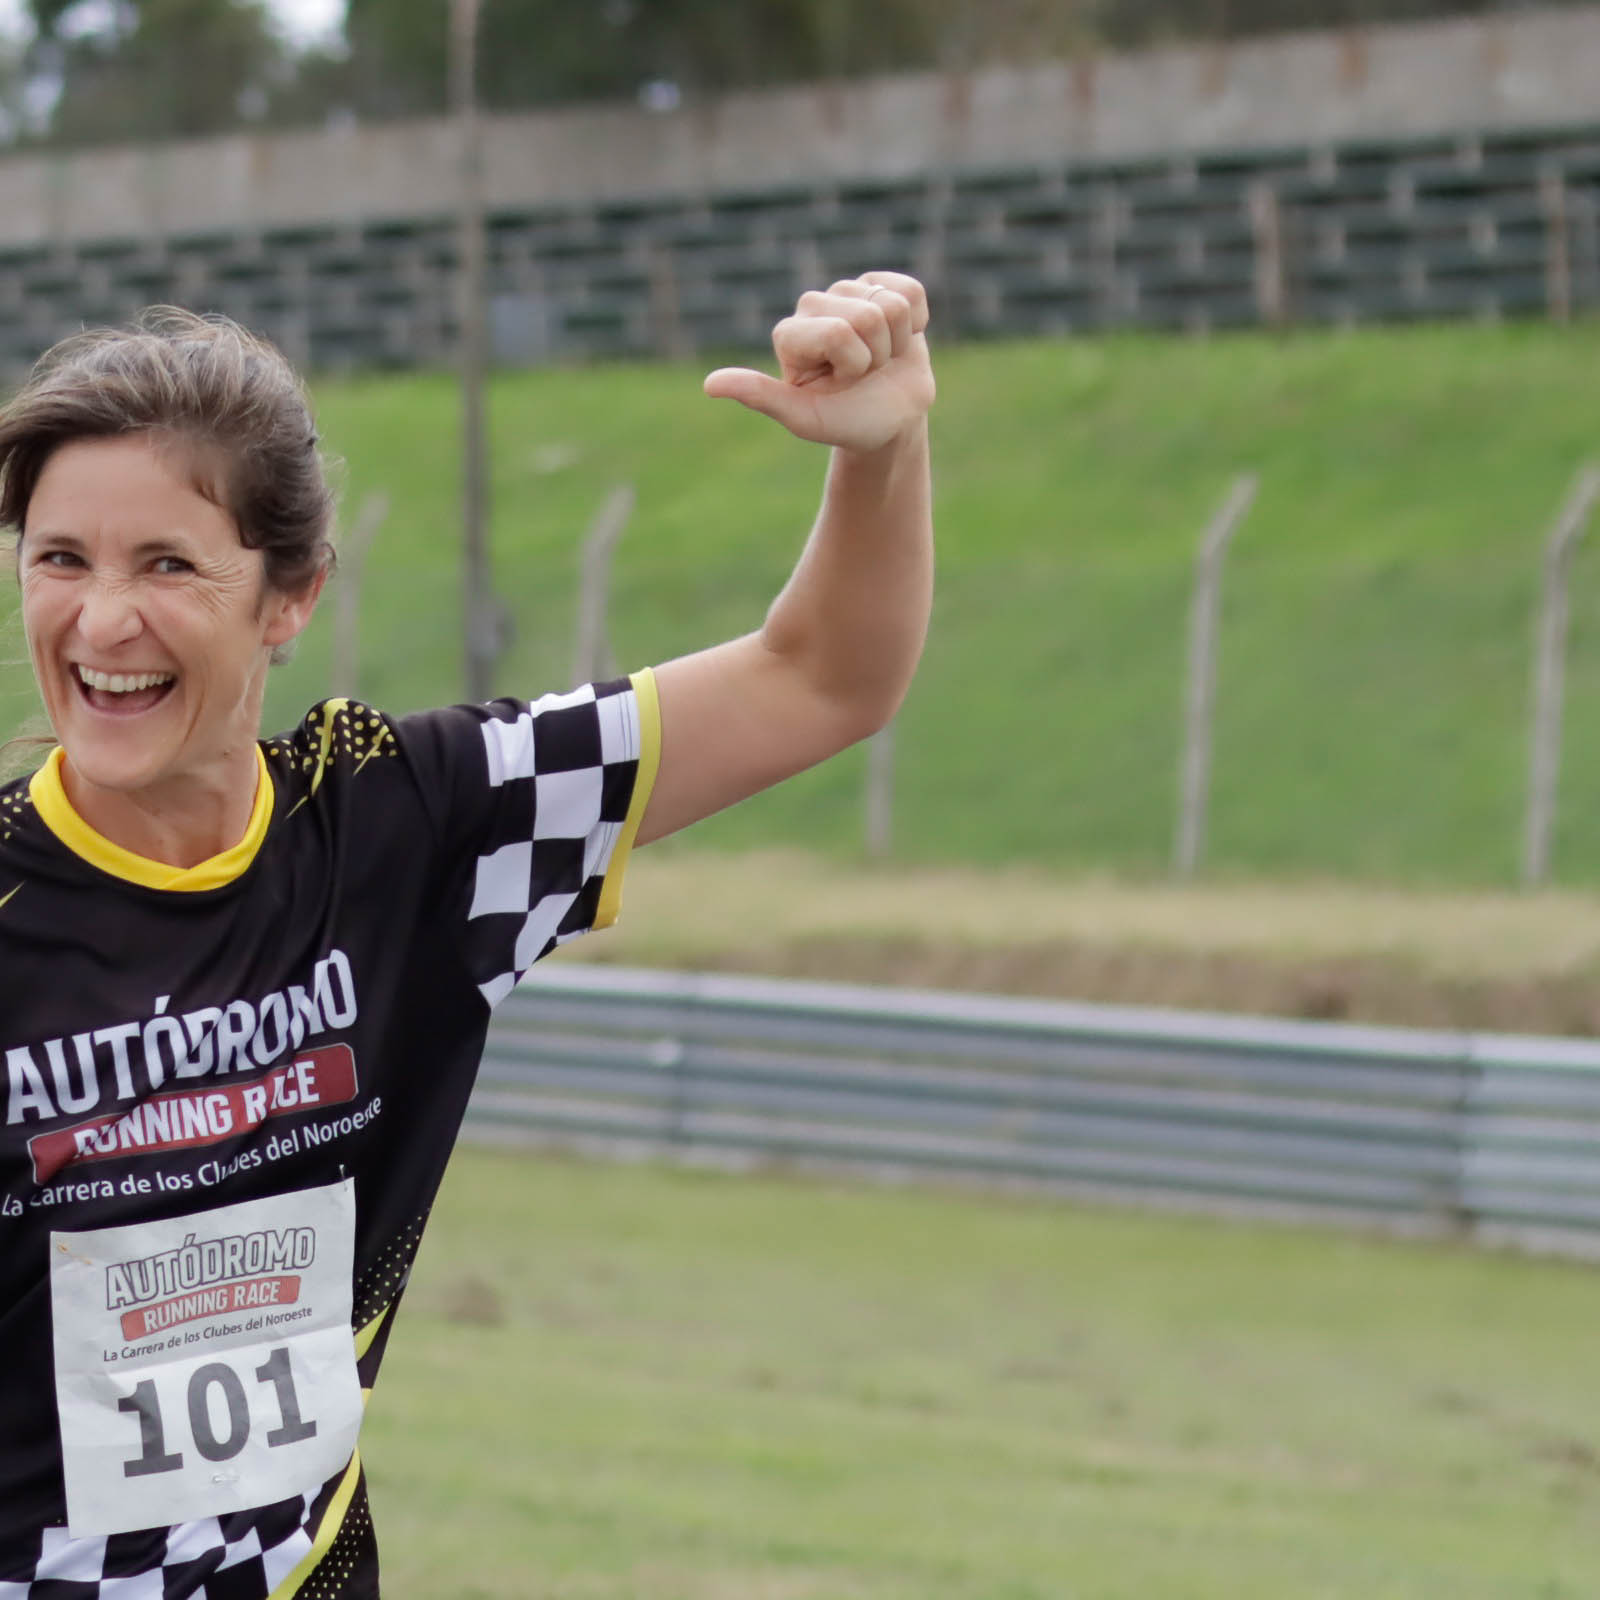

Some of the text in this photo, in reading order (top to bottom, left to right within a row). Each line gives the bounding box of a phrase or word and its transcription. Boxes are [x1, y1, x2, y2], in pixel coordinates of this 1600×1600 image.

[5, 949, 358, 1125] AUTÓDROMO
[73, 1094, 233, 1159] RUNNING
[120, 1174, 151, 1195] de
[156, 1171, 194, 1191] los
[266, 1129, 300, 1161] del
[105, 1226, 316, 1311] AUTÓDROMO
[103, 1307, 314, 1363] La Carrera de los Clubes del Noroeste
[143, 1279, 282, 1333] RUNNING RACE
[117, 1347, 318, 1478] 101
